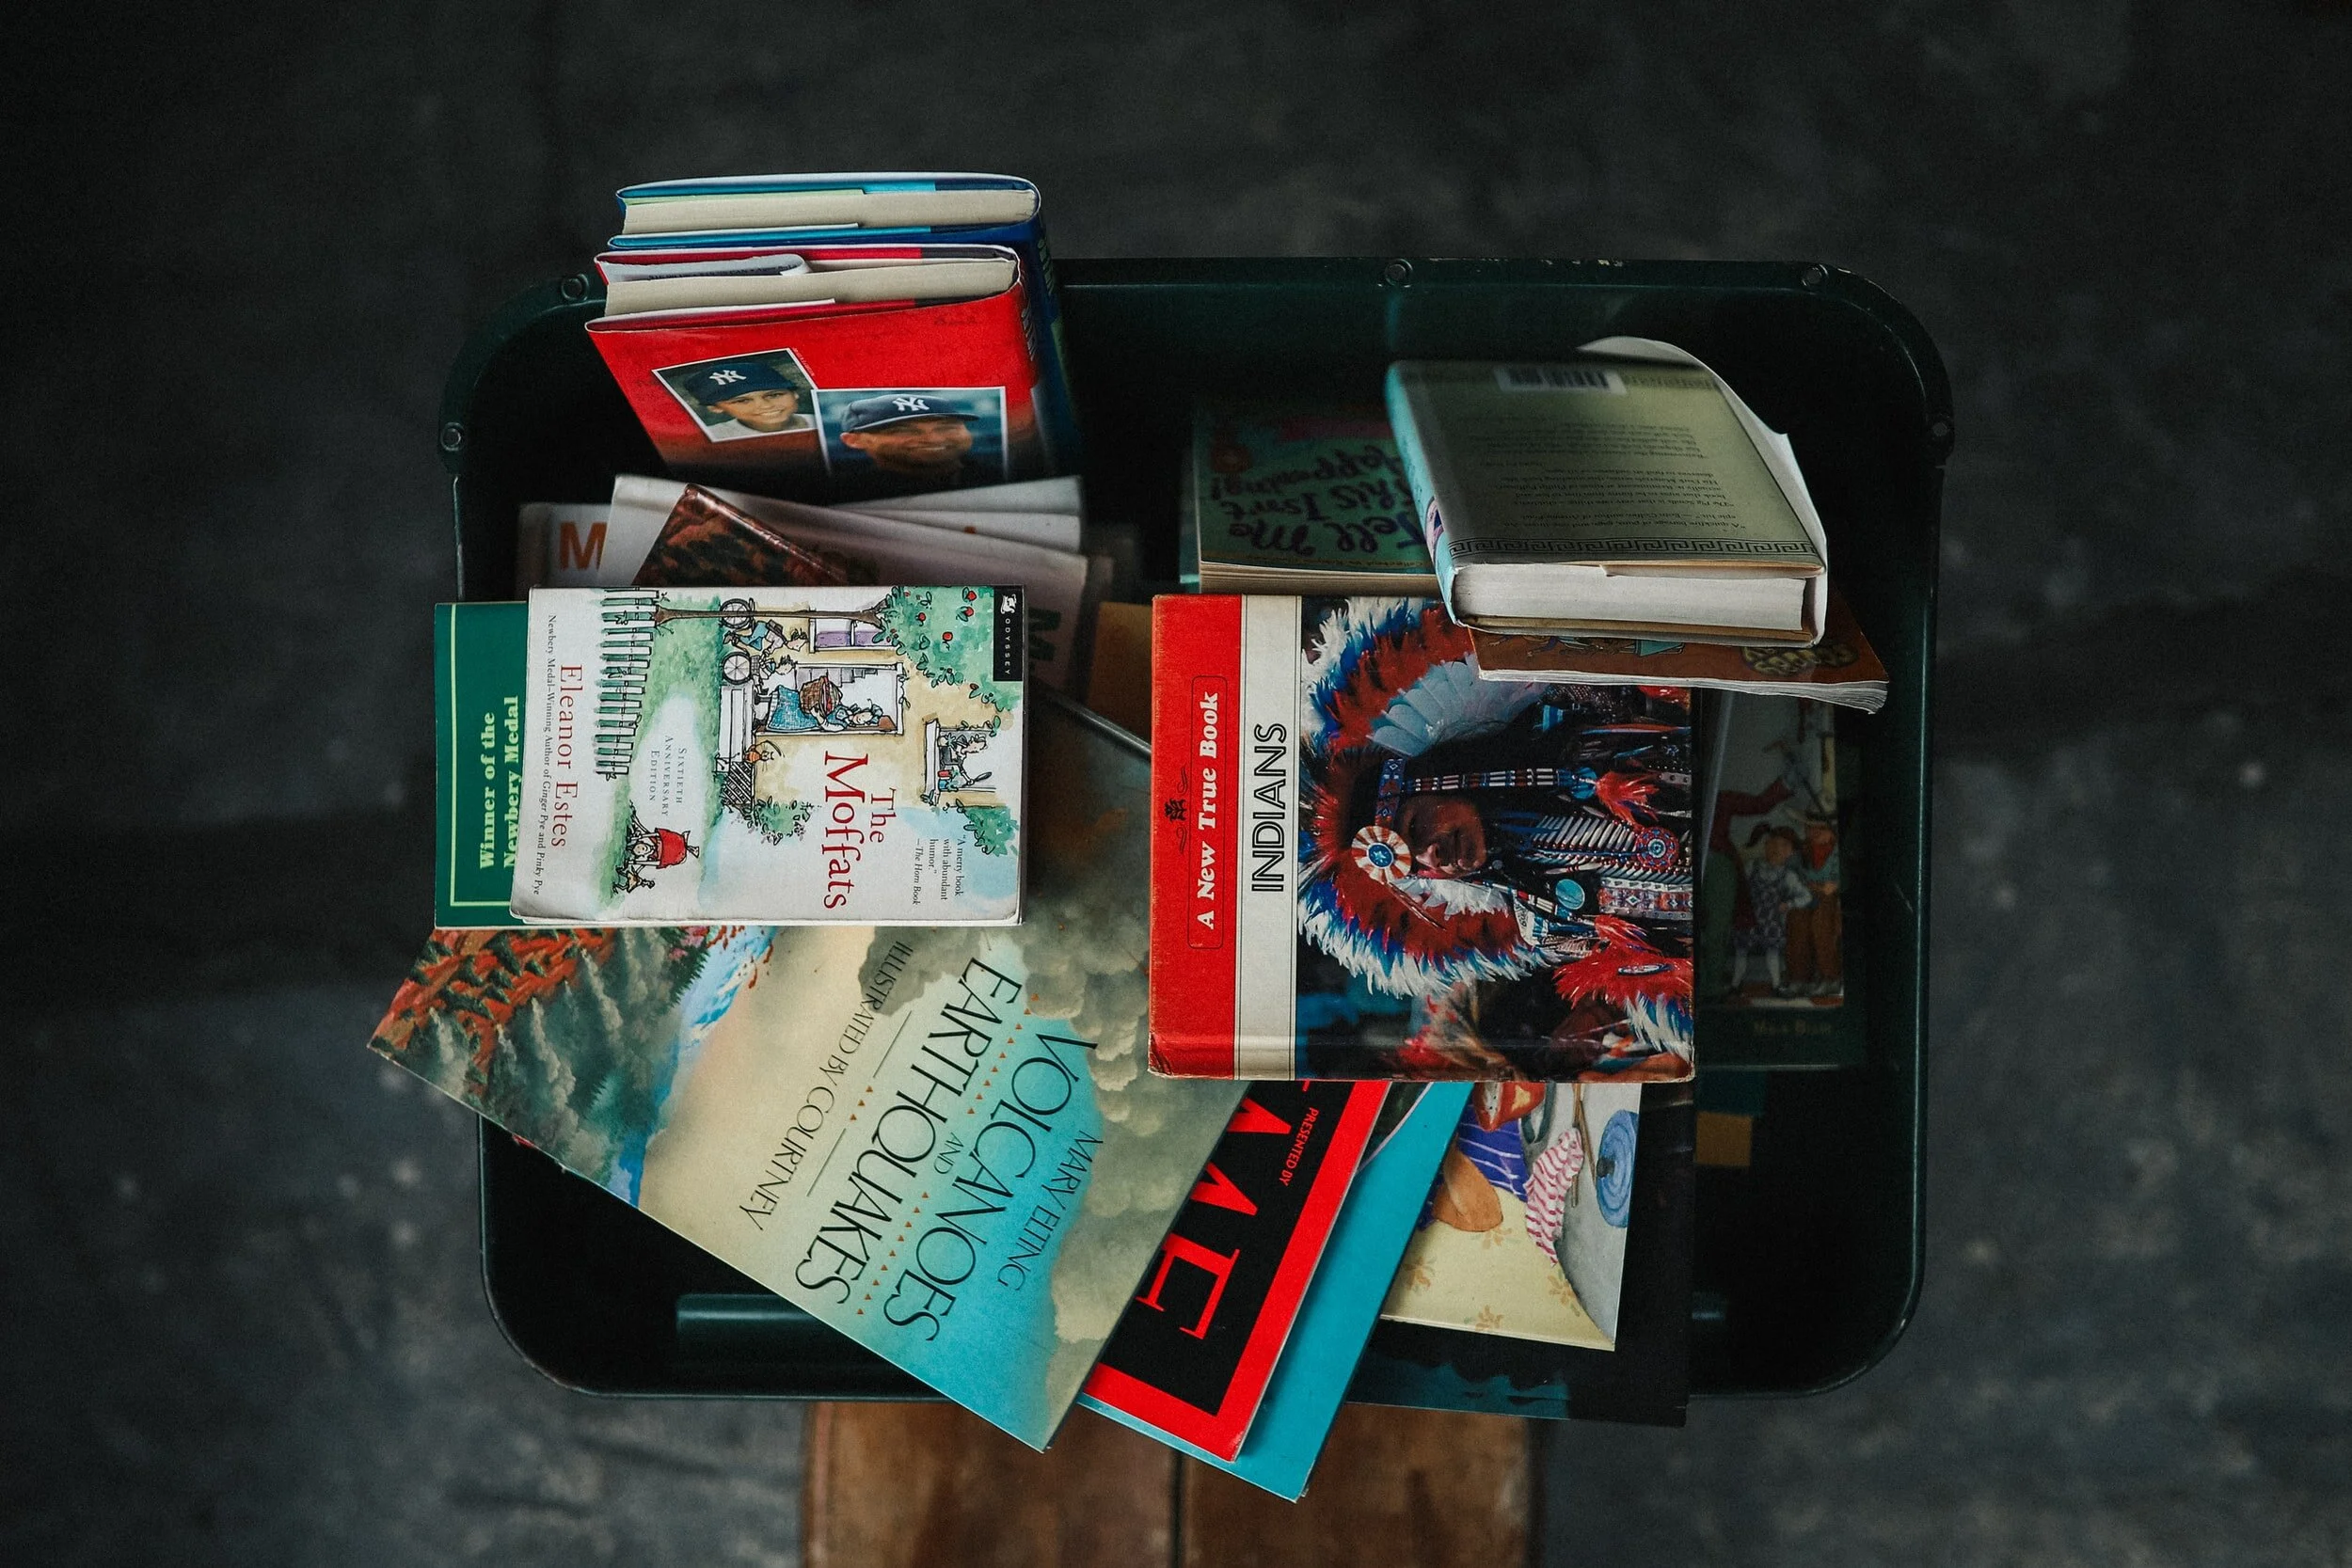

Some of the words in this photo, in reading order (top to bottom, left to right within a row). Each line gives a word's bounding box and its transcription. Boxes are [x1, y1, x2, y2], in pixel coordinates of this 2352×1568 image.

[1228, 520, 1315, 557] Me
[1324, 512, 1426, 554] Tell
[545, 614, 557, 656] Newbery
[480, 712, 495, 749] the
[503, 695, 519, 763] Medal
[556, 664, 583, 769] Eleanor
[1200, 690, 1219, 759] Book
[480, 753, 495, 780] of
[543, 735, 553, 766] Author
[542, 769, 552, 779] of
[539, 781, 551, 812] Ginger
[551, 782, 579, 848] Estes
[869, 788, 895, 844] The
[1198, 768, 1217, 830] True
[1251, 723, 1287, 893] INDIANS
[479, 786, 495, 869] Winner
[503, 771, 522, 868] Newbery
[537, 814, 548, 831] Pye
[537, 832, 547, 849] and
[823, 751, 869, 910] Moffats
[533, 851, 545, 877] Pinky
[943, 839, 952, 857] with
[954, 848, 962, 873] merry
[532, 879, 543, 896] Pye
[914, 863, 922, 883] Horn
[940, 860, 951, 900] abundant
[954, 876, 965, 896] book
[1197, 840, 1216, 900] New
[913, 886, 922, 905] Book
[1197, 909, 1215, 930] A
[839, 940, 914, 1055] ILLUSTRATED
[819, 1060, 848, 1088] BY
[794, 957, 1023, 1305] EARTHQUAKES
[1286, 1107, 1319, 1170] PRESENTED
[739, 1085, 835, 1231] COURTNEY
[933, 1132, 965, 1174] AND
[1041, 1129, 1103, 1212] MARY
[884, 1031, 1098, 1342] VOLCANOES
[1278, 1169, 1294, 1187] BY
[997, 1205, 1060, 1290] ELTING
